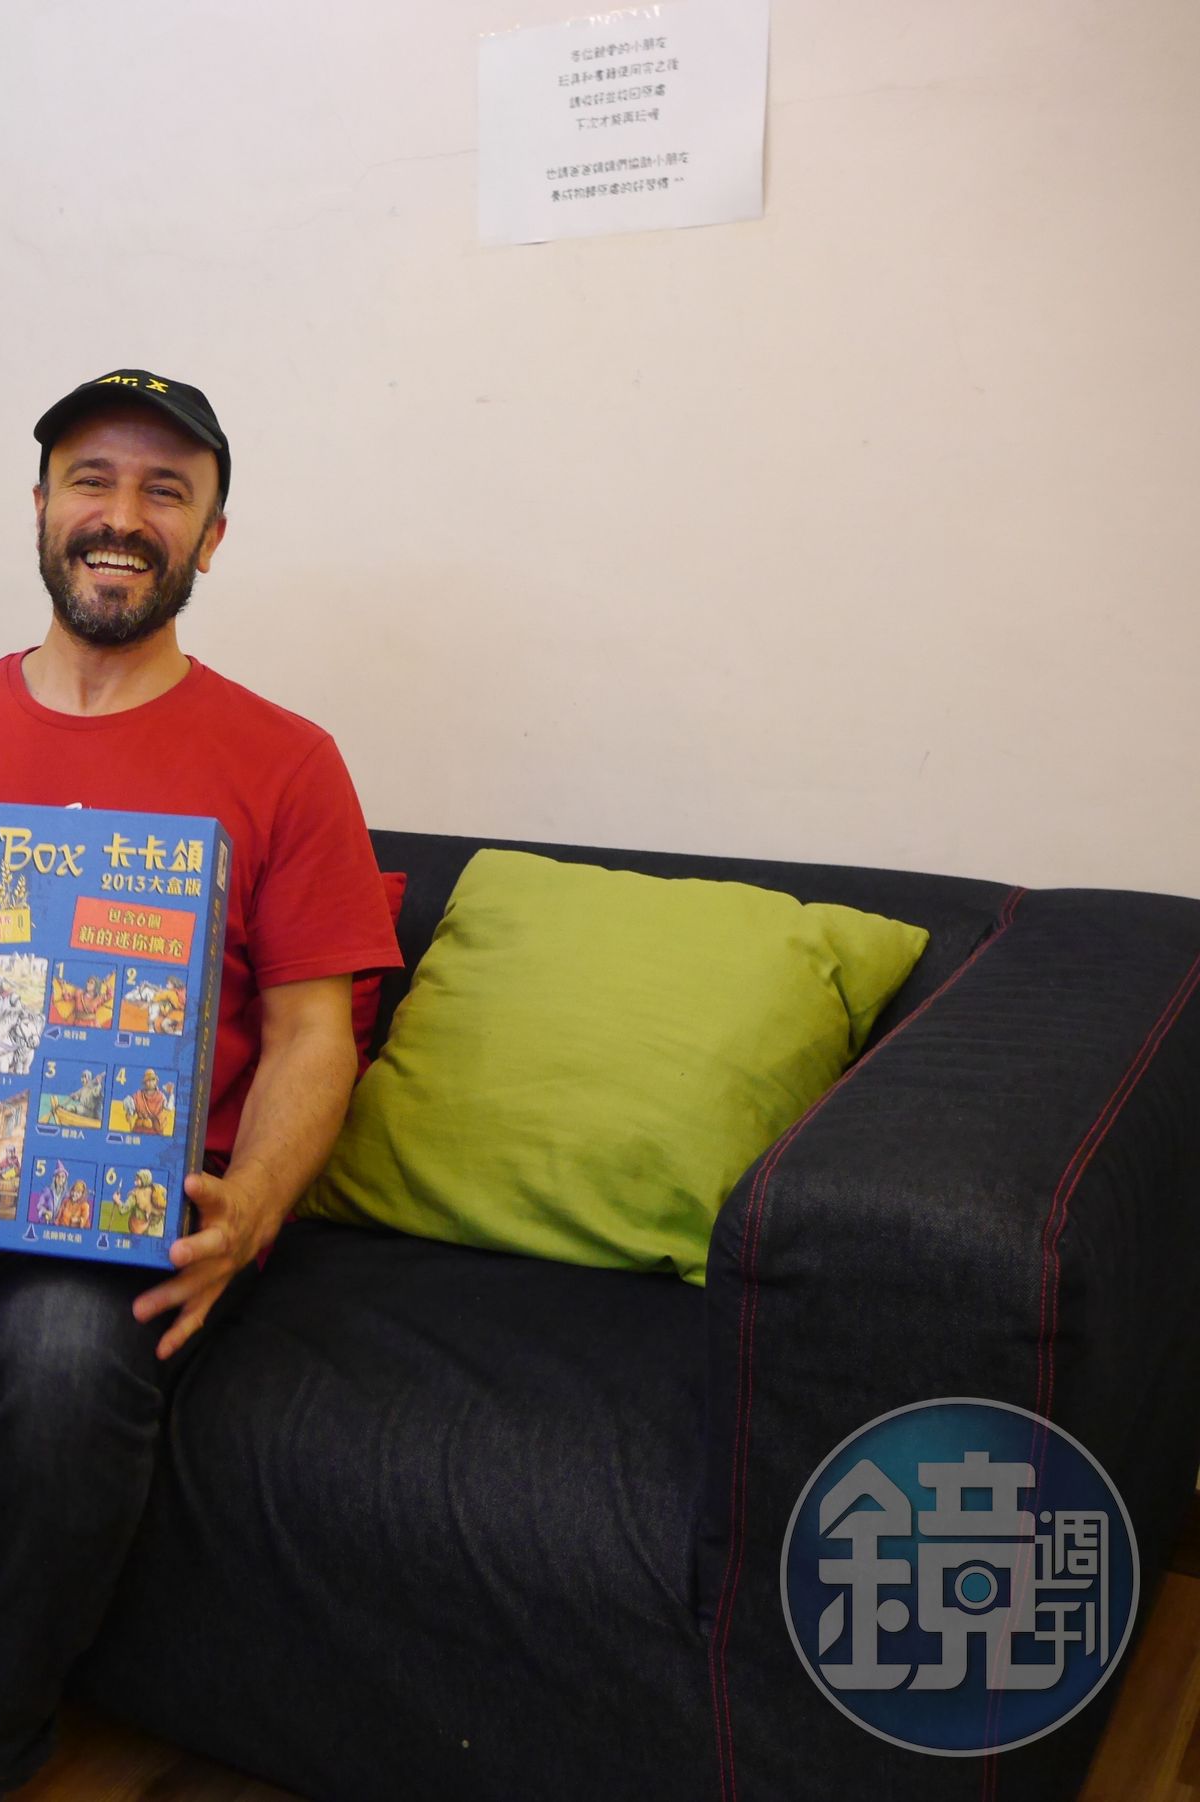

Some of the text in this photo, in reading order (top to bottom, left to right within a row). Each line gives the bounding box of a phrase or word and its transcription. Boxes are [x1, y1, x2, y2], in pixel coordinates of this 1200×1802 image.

[145, 378, 169, 394] X
[103, 832, 204, 873] 卡卡頌
[101, 873, 201, 897] 2013大盒版
[79, 924, 184, 958] 新的迷你擴充
[55, 961, 65, 978] 1
[126, 968, 137, 985] 2
[44, 1061, 56, 1078] 3
[115, 1067, 127, 1085] 4
[35, 1160, 47, 1177] 5
[105, 1168, 117, 1185] 6
